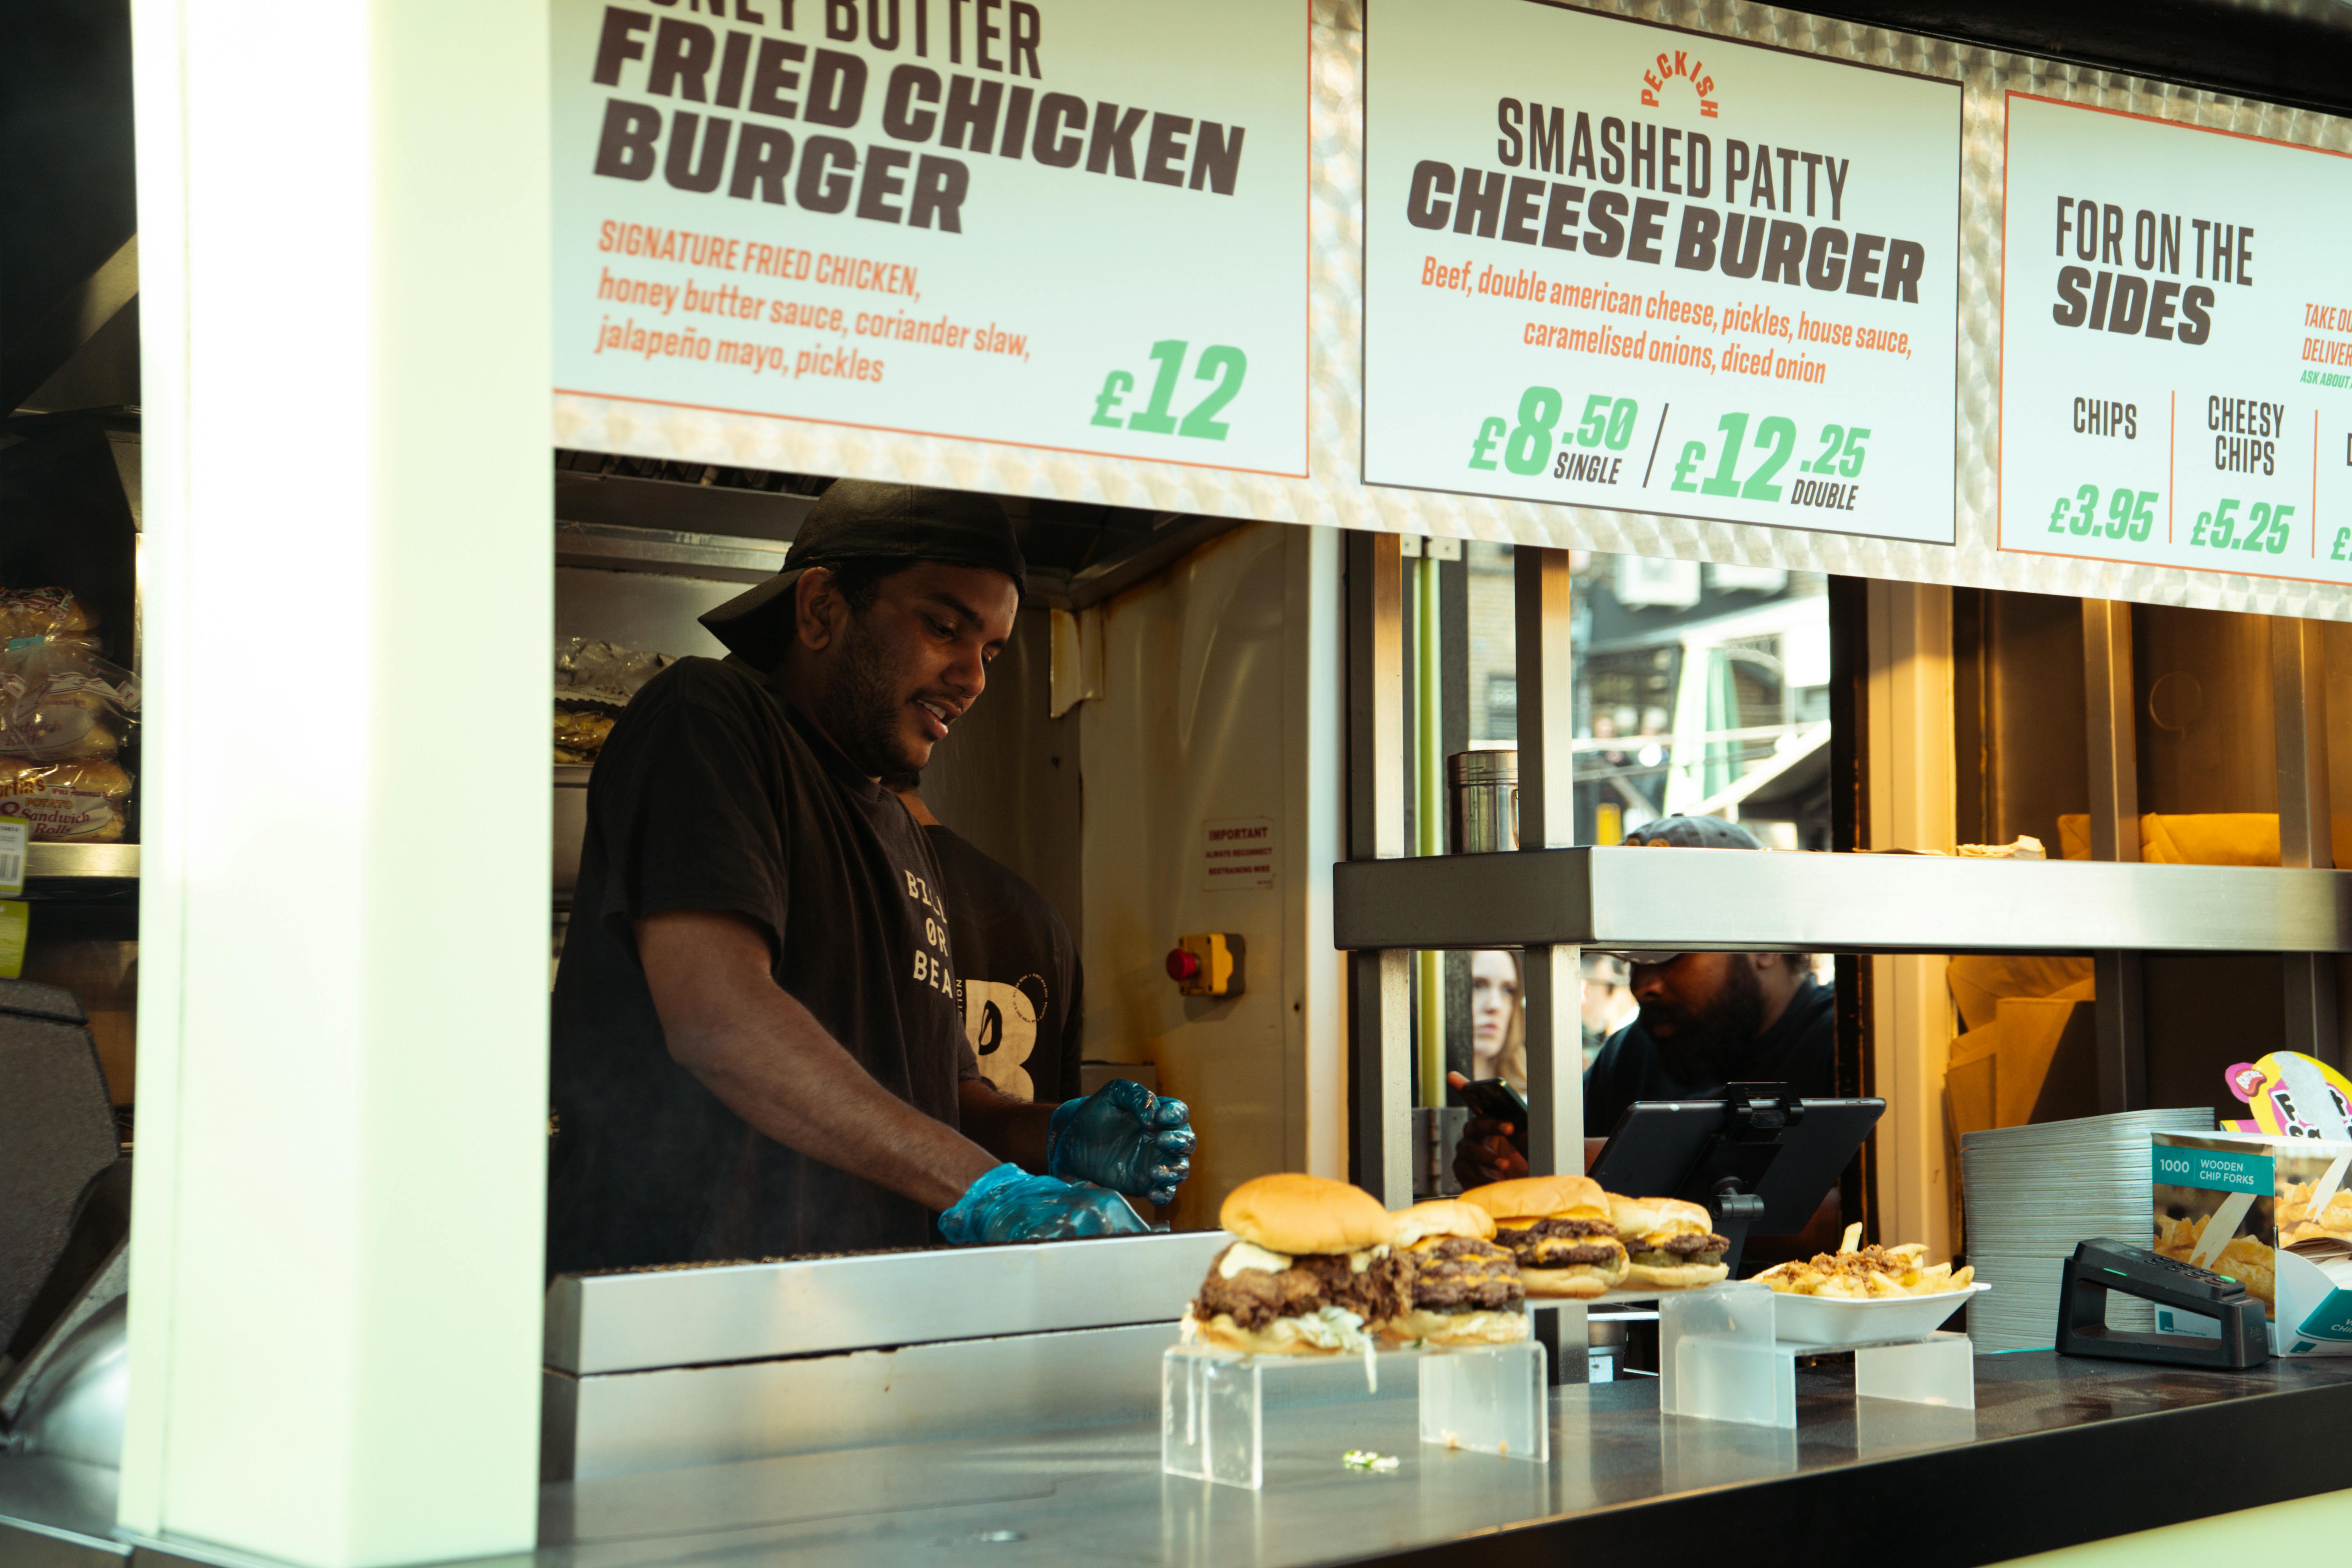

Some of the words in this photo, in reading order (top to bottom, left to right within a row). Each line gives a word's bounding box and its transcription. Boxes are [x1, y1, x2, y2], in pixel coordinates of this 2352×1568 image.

[593, 0, 867, 128] FRIED
[883, 64, 1245, 195] CHICKEN
[1642, 51, 1718, 118] PECKISH
[594, 98, 969, 233] BURGER
[1498, 98, 1711, 198] SMASHED
[1726, 139, 1849, 221] PATTY
[1407, 160, 1669, 264] CHEESE
[1675, 205, 1924, 305] BURGER
[2056, 196, 2123, 266] FOR
[2135, 210, 2181, 274] ON
[2192, 219, 2254, 286] THE
[599, 220, 740, 270] SIGNATURE
[743, 242, 811, 280] FRIED
[816, 253, 920, 302] CHICKEN,
[598, 267, 679, 315] honey
[683, 279, 765, 319] butter
[770, 301, 847, 337] sauce,
[856, 310, 971, 347] coriander
[974, 323, 1029, 362] slaw,
[1422, 256, 1472, 296] Beef,
[1479, 268, 1546, 302] double
[1550, 282, 1642, 316] american
[1646, 290, 1717, 332] cheese,
[1722, 302, 1793, 343] pickles,
[1798, 311, 1852, 346] house
[1856, 328, 1911, 359] sauce,
[2053, 266, 2214, 345] SIDES
[2305, 304, 2336, 330] TAKE
[595, 316, 711, 360] jalapeño
[717, 341, 788, 377] mayo,
[795, 345, 884, 382] pickles
[1524, 323, 1647, 359] caramelised
[1649, 335, 1715, 374] onions,
[1722, 343, 1774, 376] diced
[1776, 353, 1825, 383] onion
[1091, 340, 1247, 440] £12
[2300, 370, 2320, 384] ASK
[2319, 373, 2350, 388] ABOUT
[1469, 386, 1639, 476] £8.50
[2074, 397, 2136, 439] CHIPS
[2209, 396, 2284, 438] CHEESY
[1554, 452, 1622, 484] SINGLE
[1671, 412, 1871, 502] £12.25
[2216, 436, 2274, 475] CHIPS
[1791, 479, 1858, 510] DOUBLE
[2048, 485, 2159, 542] £3.95
[2190, 499, 2295, 554] £5.25
[20, 809, 90, 824] Sandwich
[25, 797, 73, 809] POTATO
[34, 823, 72, 834] Rolls
[1206, 849, 1230, 858] ALWAYS
[1233, 847, 1272, 857] RECONNECT
[1209, 827, 1267, 841] IMPORTANT
[2160, 1158, 2190, 1173] 1000
[2200, 1159, 2243, 1172] WOODEN
[2200, 1170, 2221, 1182] CHIP
[2223, 1172, 2254, 1185] FORKS
